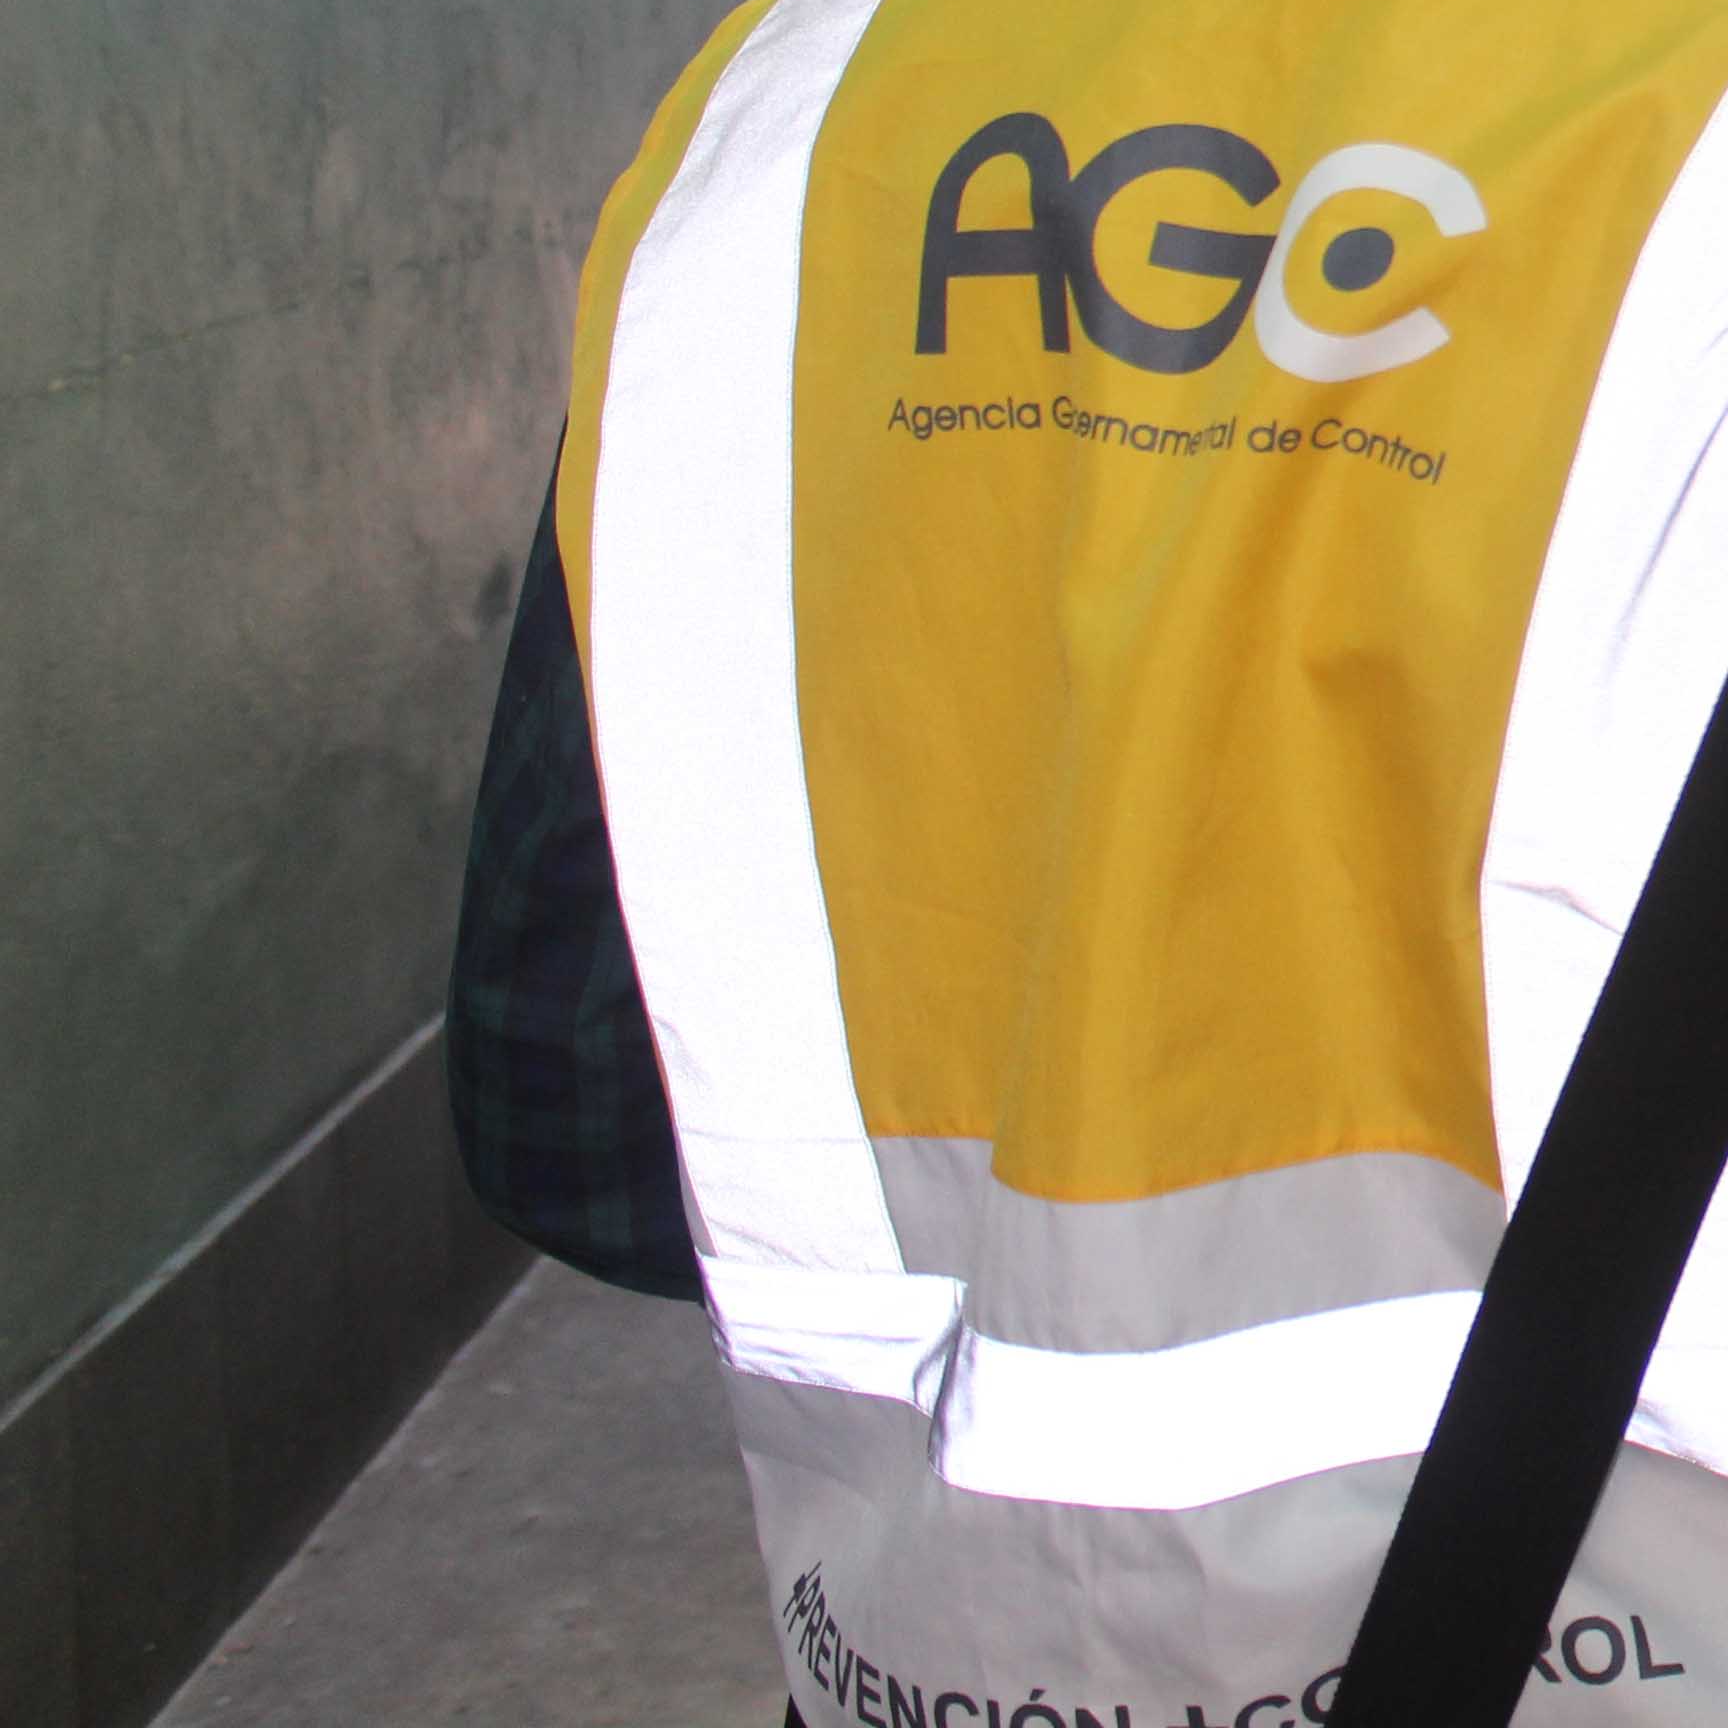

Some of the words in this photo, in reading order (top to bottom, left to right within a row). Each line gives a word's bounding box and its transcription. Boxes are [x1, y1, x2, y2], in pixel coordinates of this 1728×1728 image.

[914, 111, 1488, 384] AGC
[887, 396, 1041, 441] Agencia
[1247, 419, 1302, 454] de
[1311, 418, 1446, 486] Control
